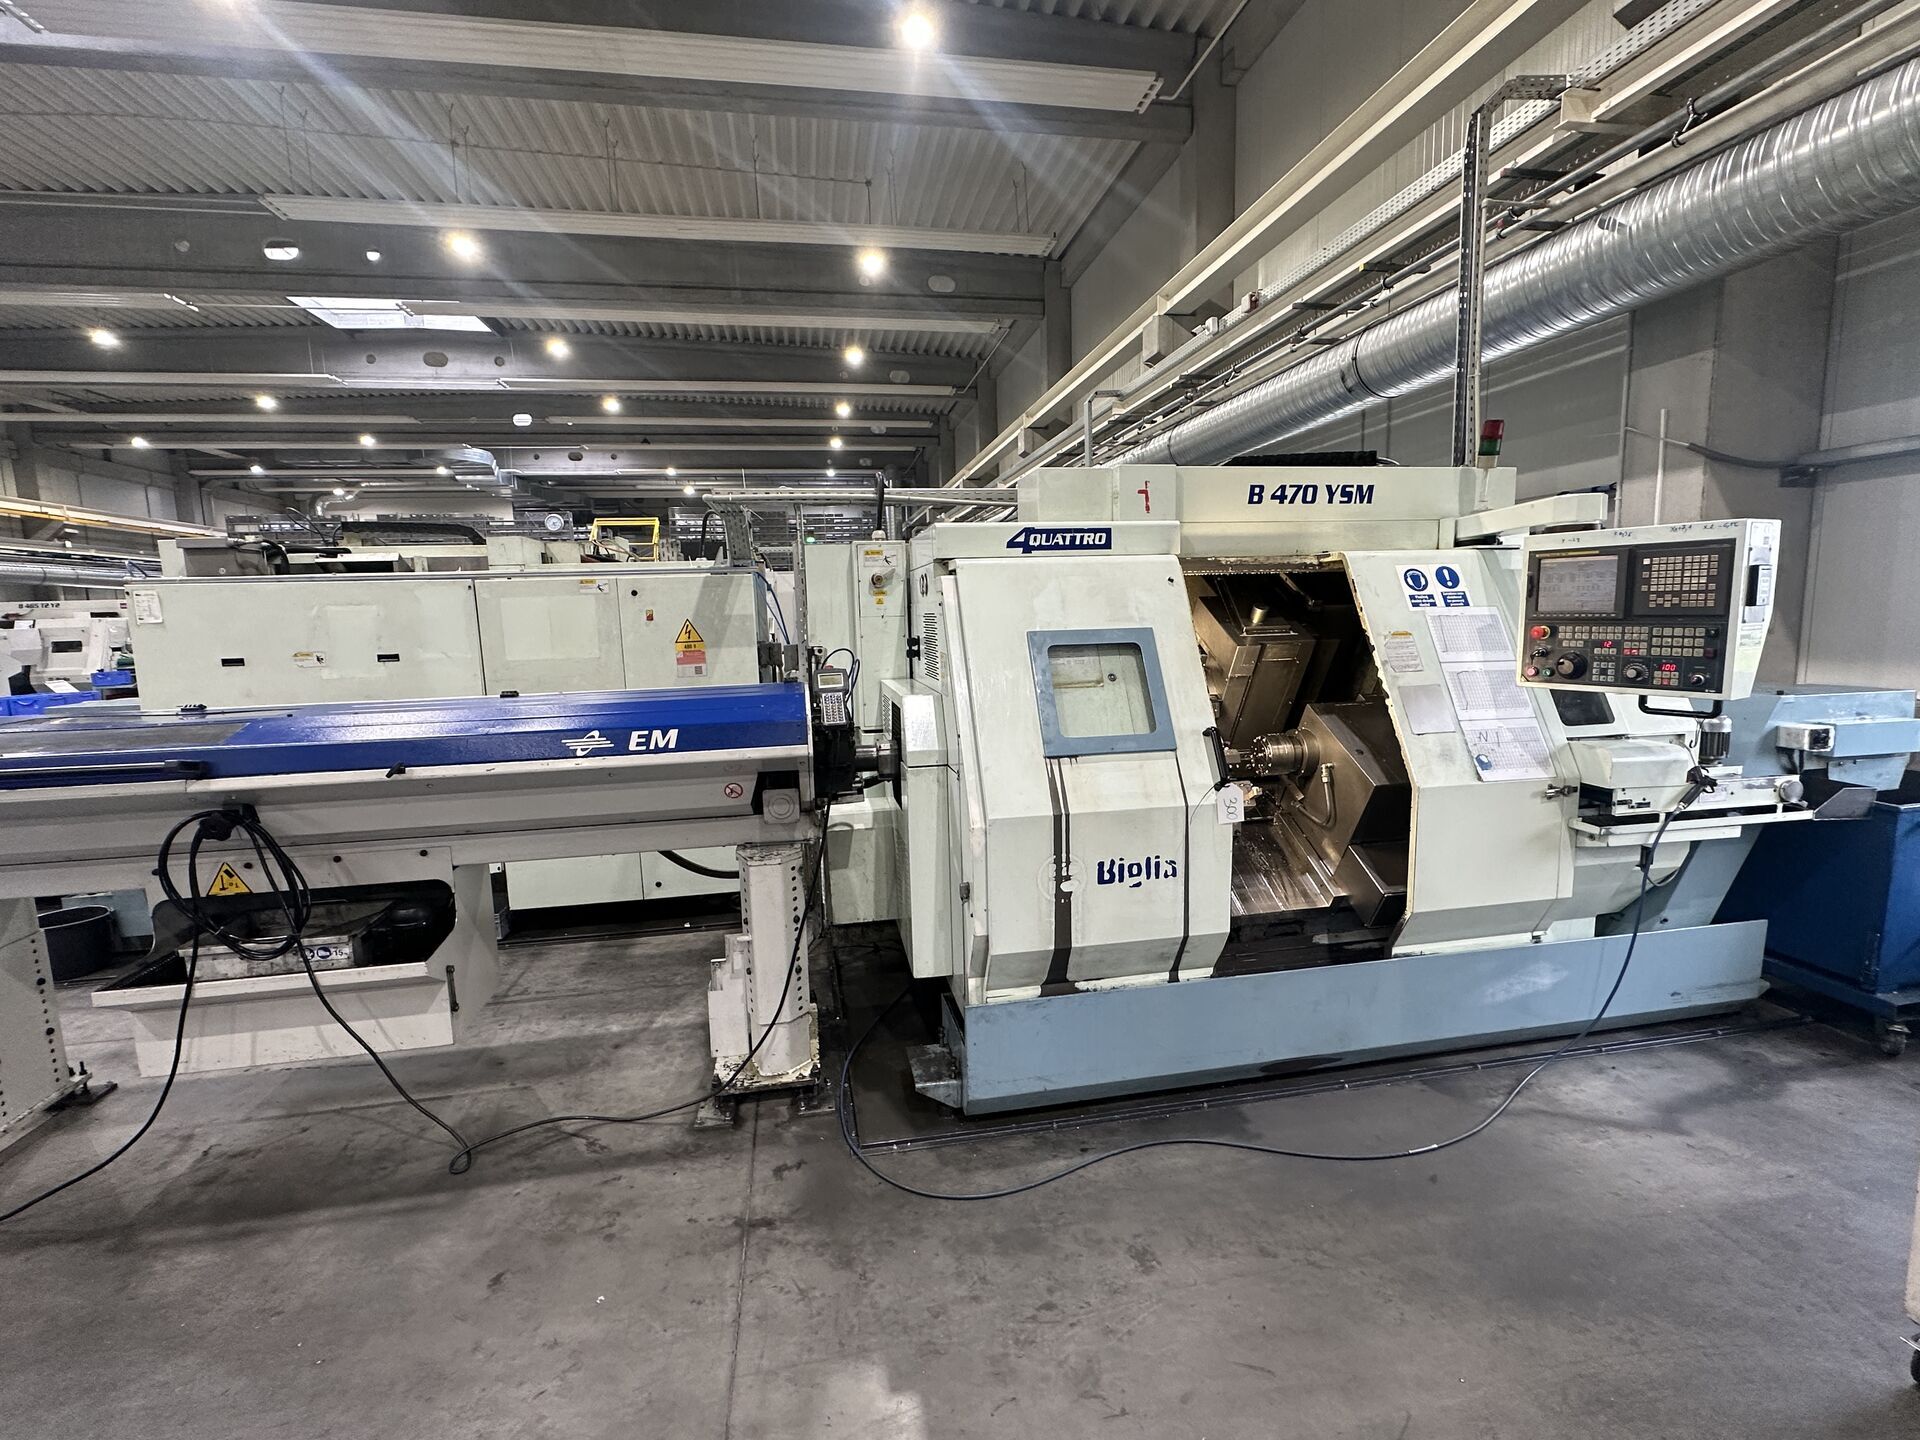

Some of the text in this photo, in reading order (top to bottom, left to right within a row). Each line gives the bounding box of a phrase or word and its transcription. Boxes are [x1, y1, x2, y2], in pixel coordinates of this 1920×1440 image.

[1247, 484, 1375, 505] B 470 YSM
[628, 728, 679, 751] EM
